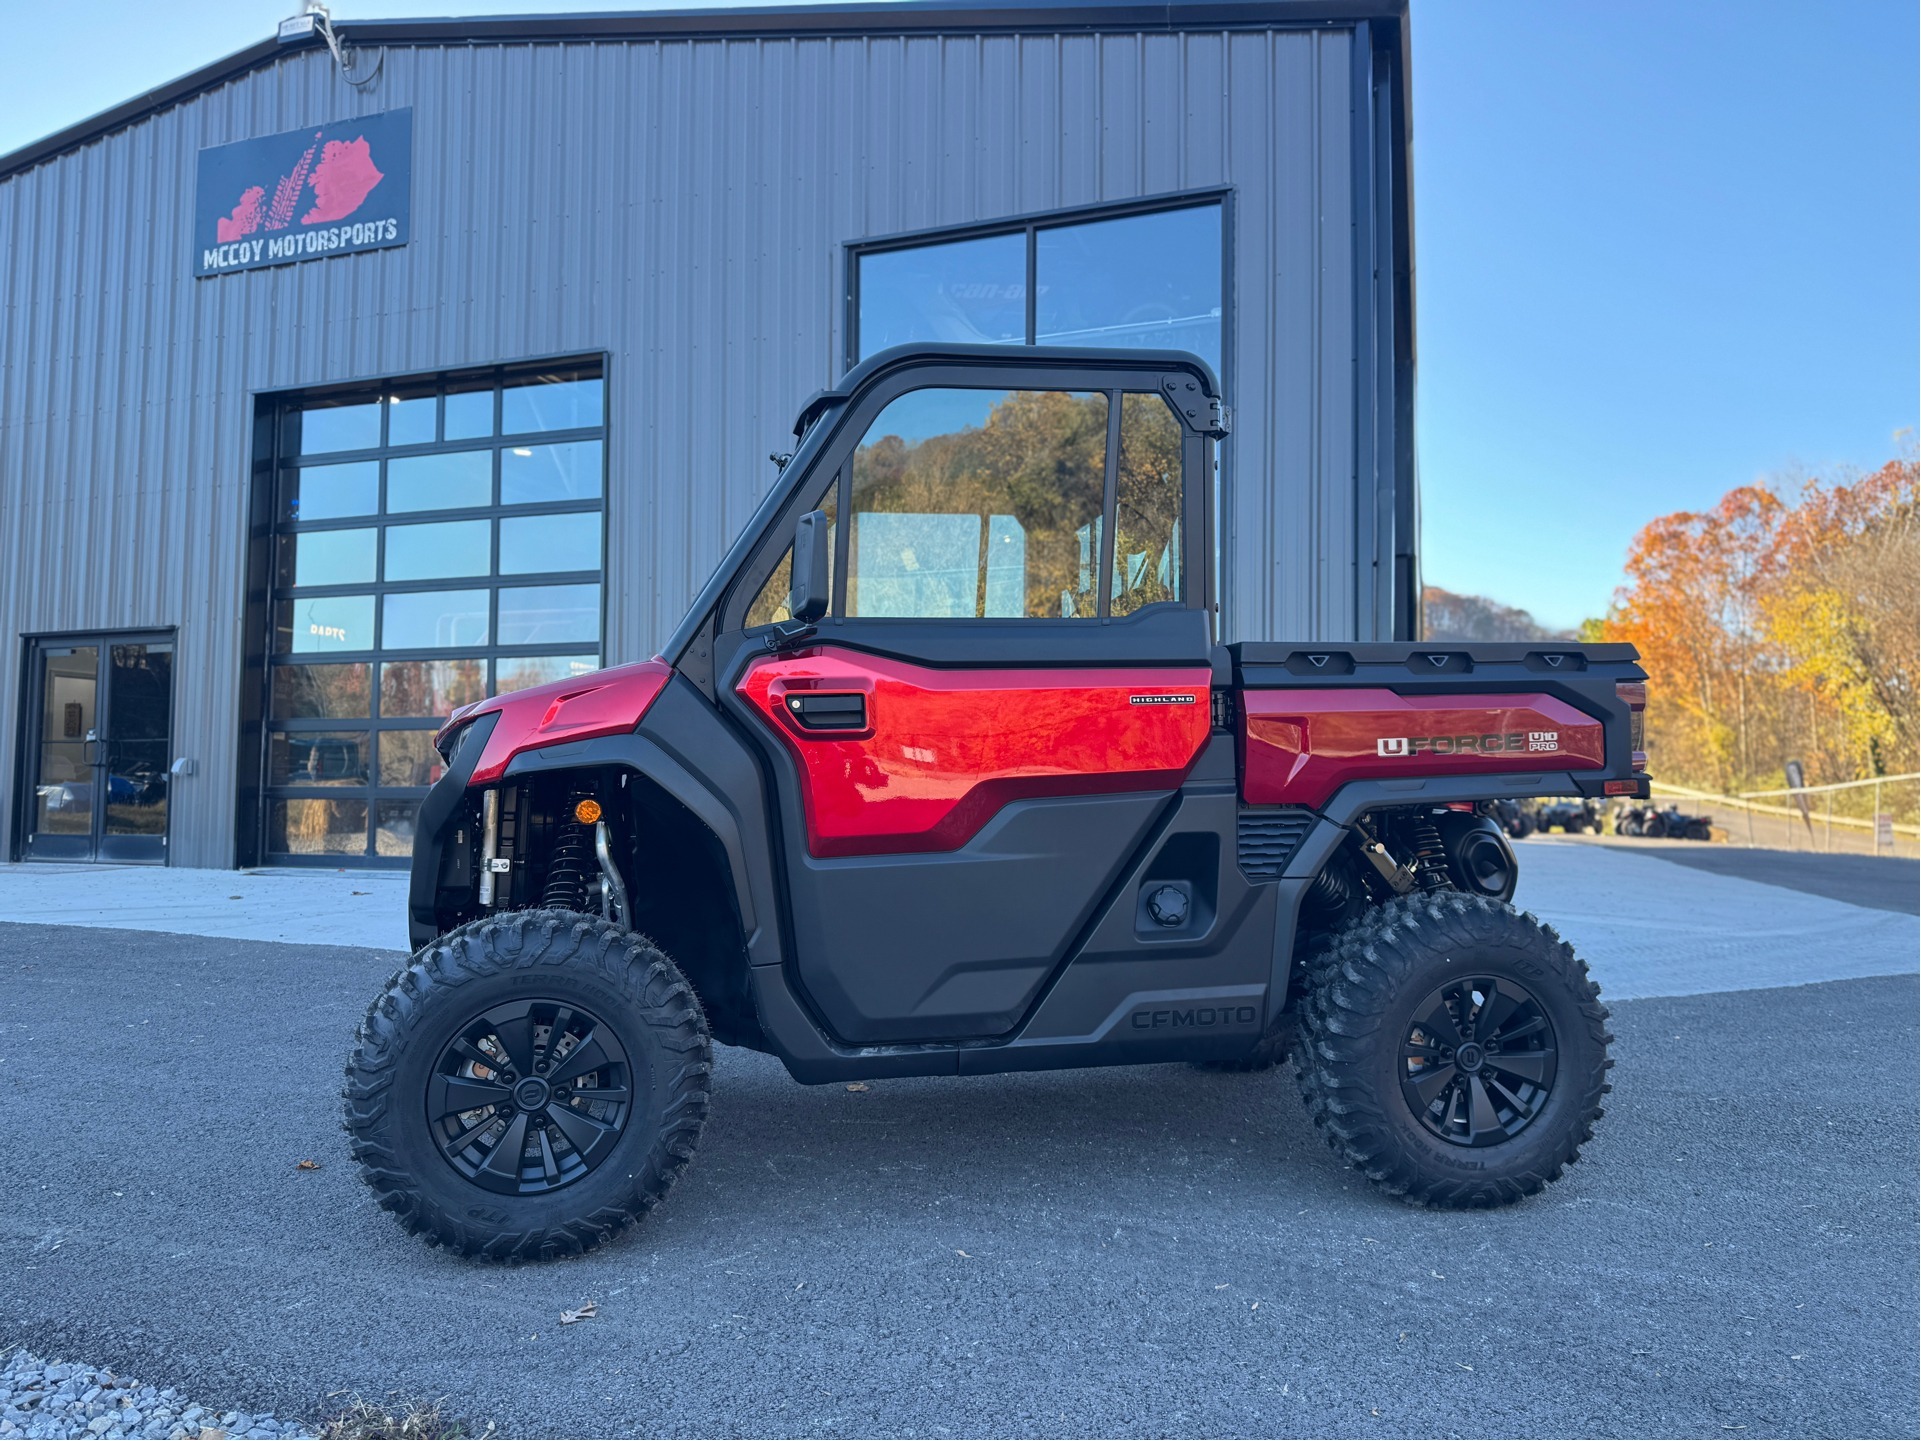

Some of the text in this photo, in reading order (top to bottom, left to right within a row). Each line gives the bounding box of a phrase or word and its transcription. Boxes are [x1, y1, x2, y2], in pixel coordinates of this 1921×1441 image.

[203, 217, 397, 270] MCCOY MOTORSPORTS
[1529, 732, 1558, 742] U10
[1529, 742, 1558, 751] PRO
[1131, 1006, 1257, 1029] CFMOTO
